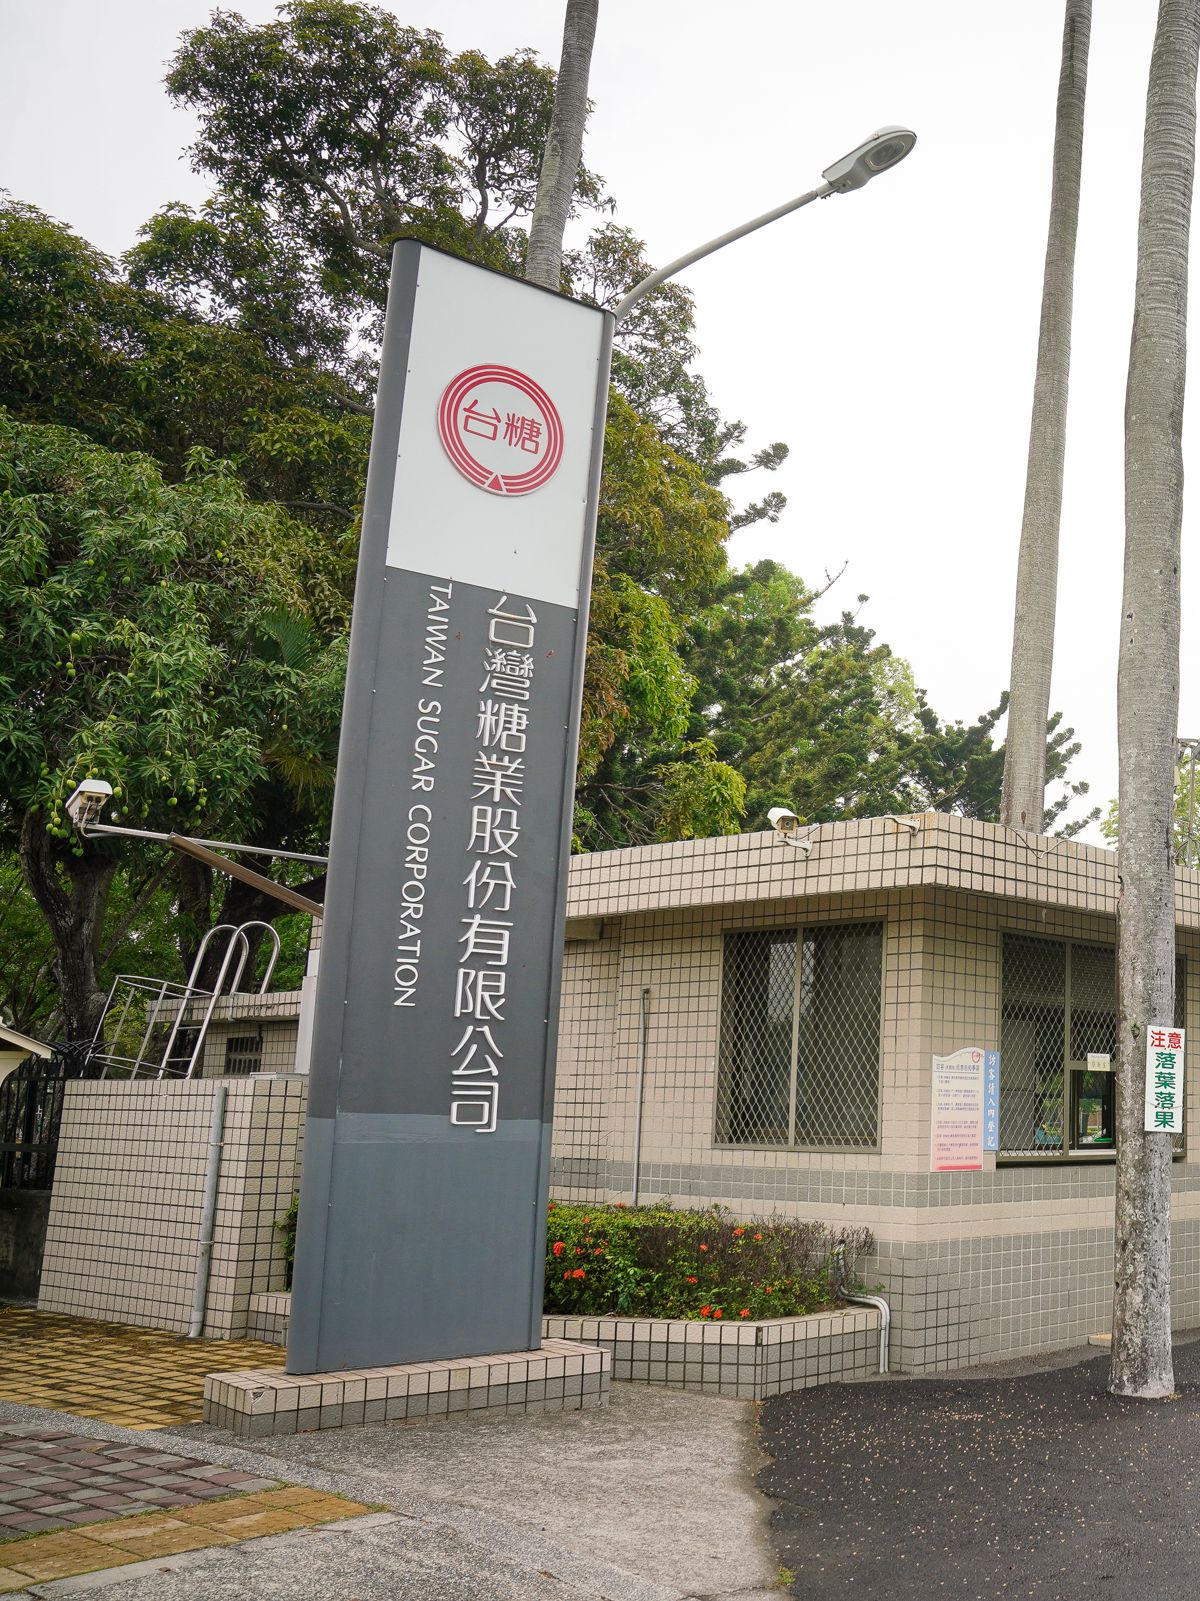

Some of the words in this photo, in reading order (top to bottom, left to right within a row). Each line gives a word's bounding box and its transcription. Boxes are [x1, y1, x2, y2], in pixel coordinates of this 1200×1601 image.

[463, 399, 543, 455] 台糖
[421, 582, 453, 688] TAIWAN
[411, 699, 442, 793] SUGAR
[393, 804, 432, 1007] CORPORATION
[449, 594, 539, 1134] 台灣糖業股份有限公司
[1150, 1030, 1182, 1050] 注意
[1154, 1051, 1176, 1129] 落葉落果
